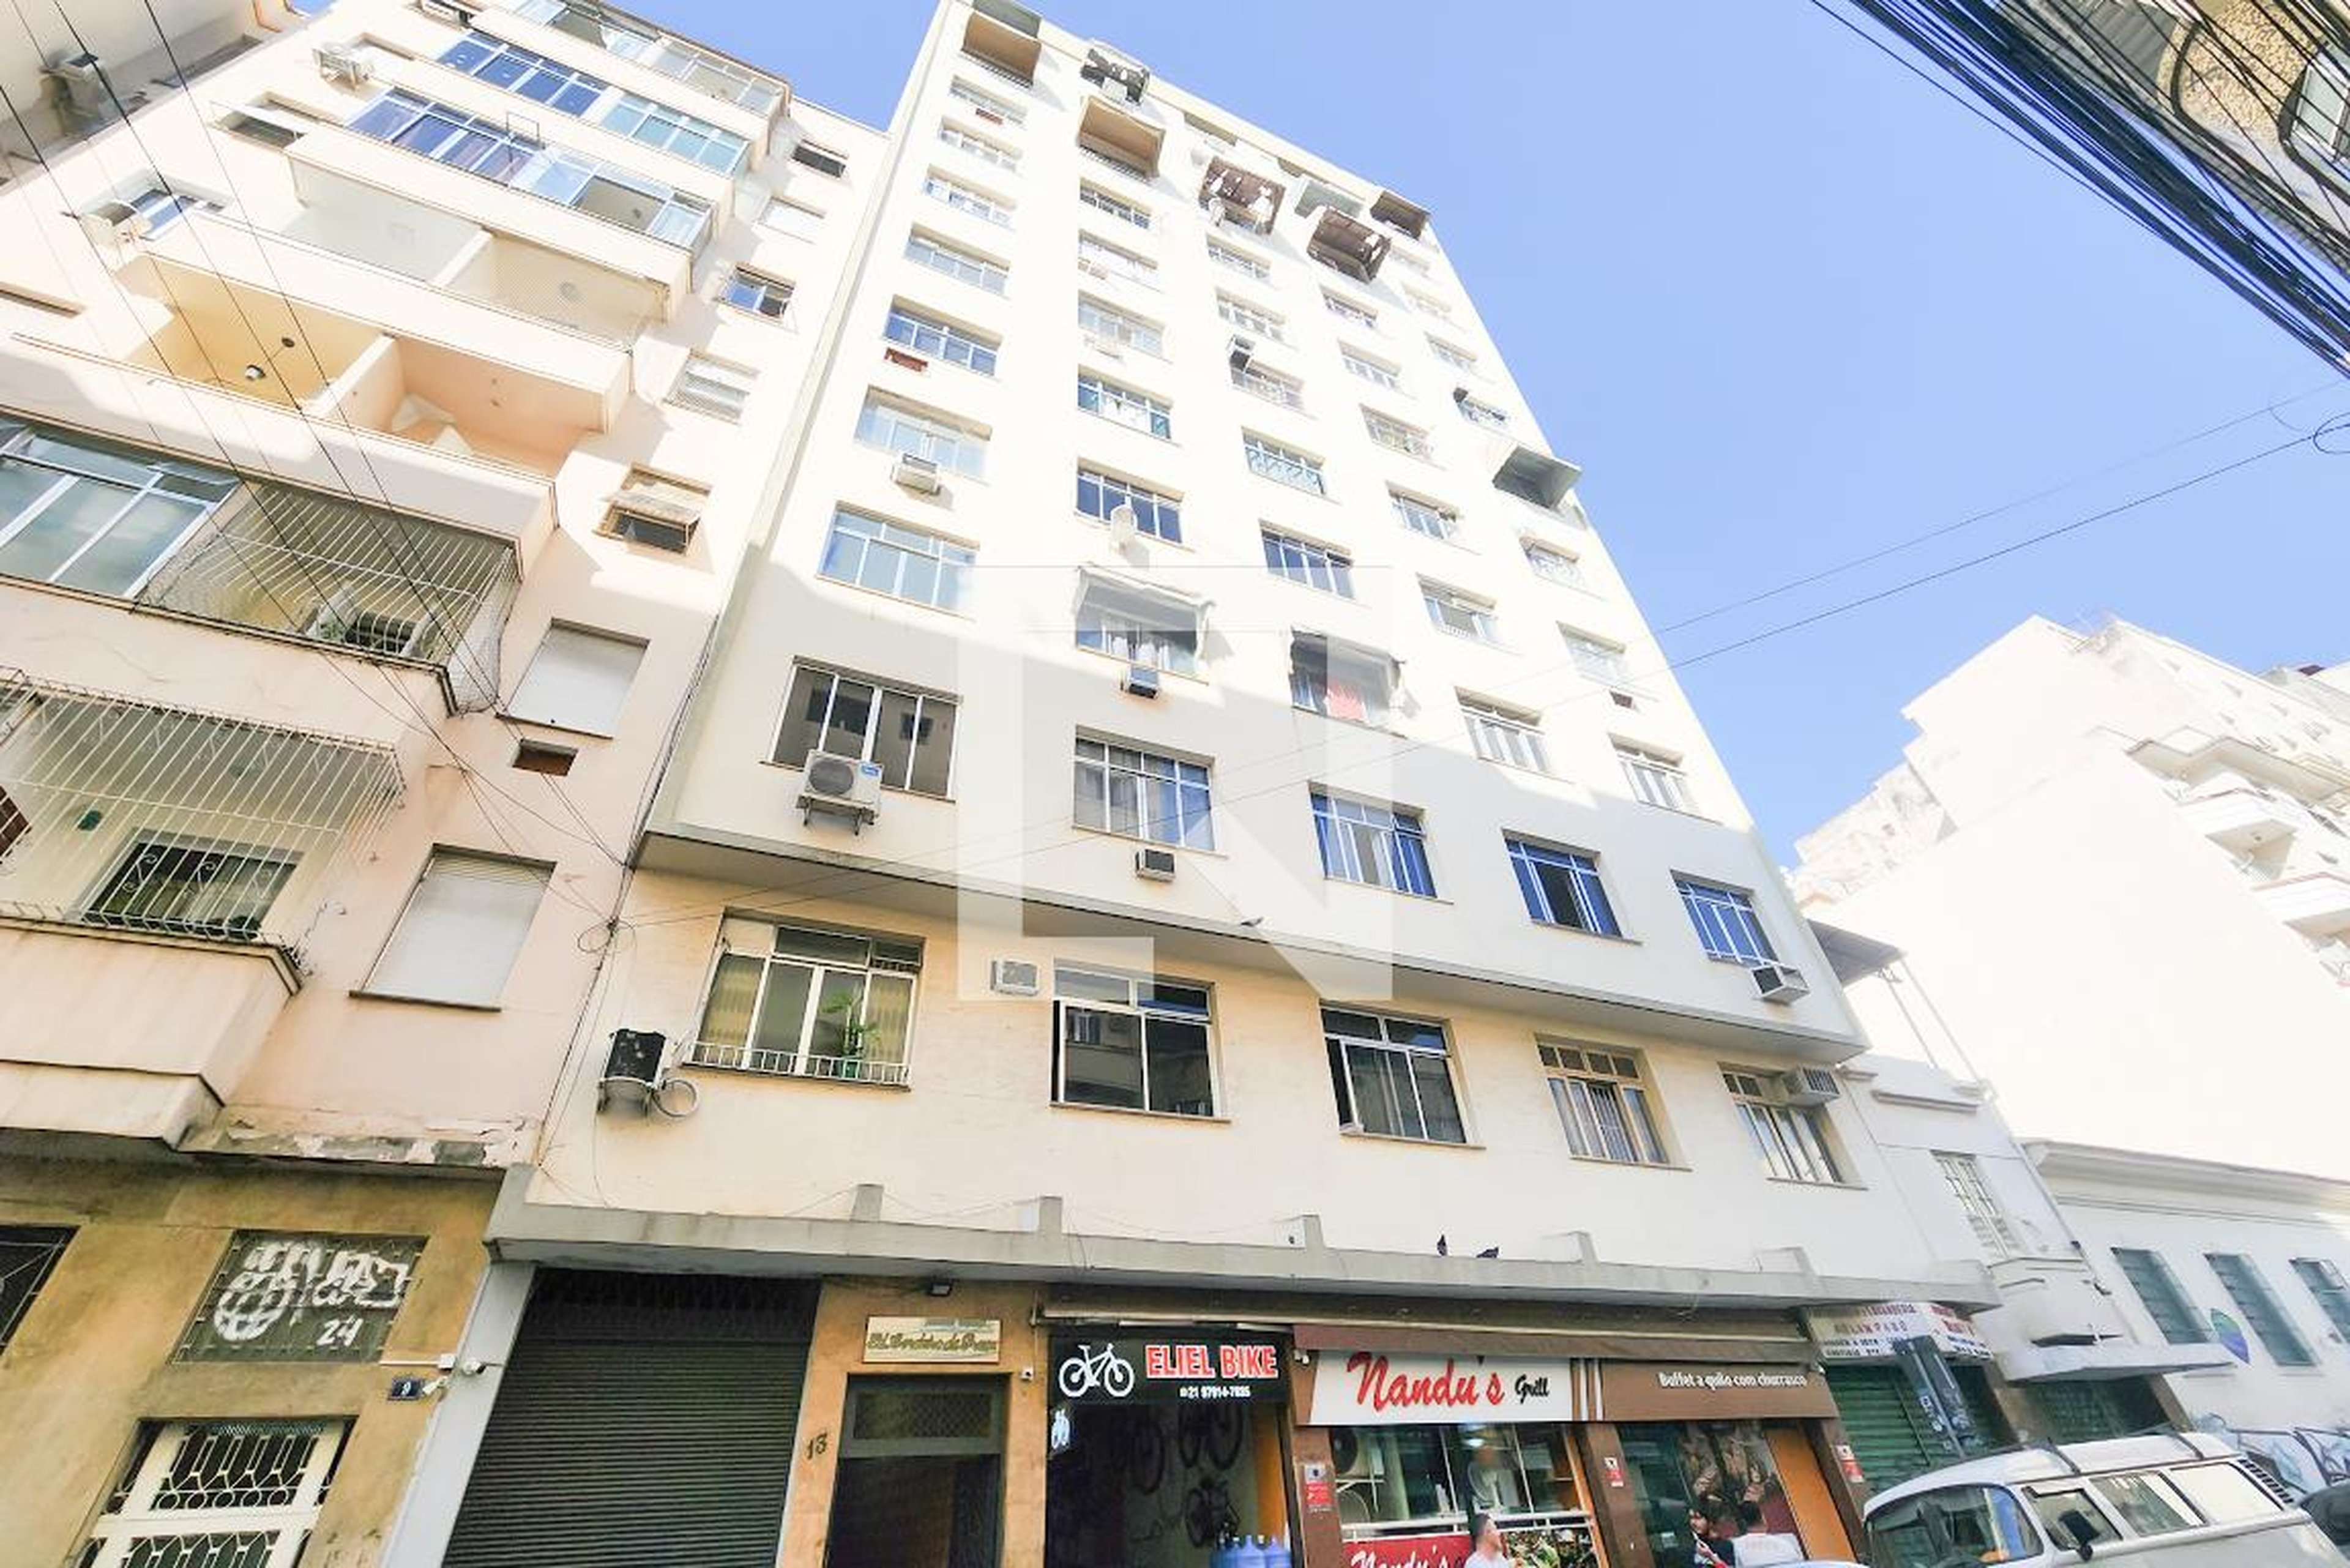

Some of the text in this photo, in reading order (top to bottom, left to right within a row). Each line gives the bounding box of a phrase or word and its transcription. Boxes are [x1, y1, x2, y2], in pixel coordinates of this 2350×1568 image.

[316, 1316, 364, 1346] 24
[1145, 1345, 1278, 1378] ELIEL BIKE
[1346, 1351, 1550, 1411] Nandu's Grill
[1659, 1372, 1695, 1387] Buffet
[1734, 1376, 1756, 1387] com
[1757, 1372, 1807, 1387] churrasco
[807, 1432, 827, 1461] 13
